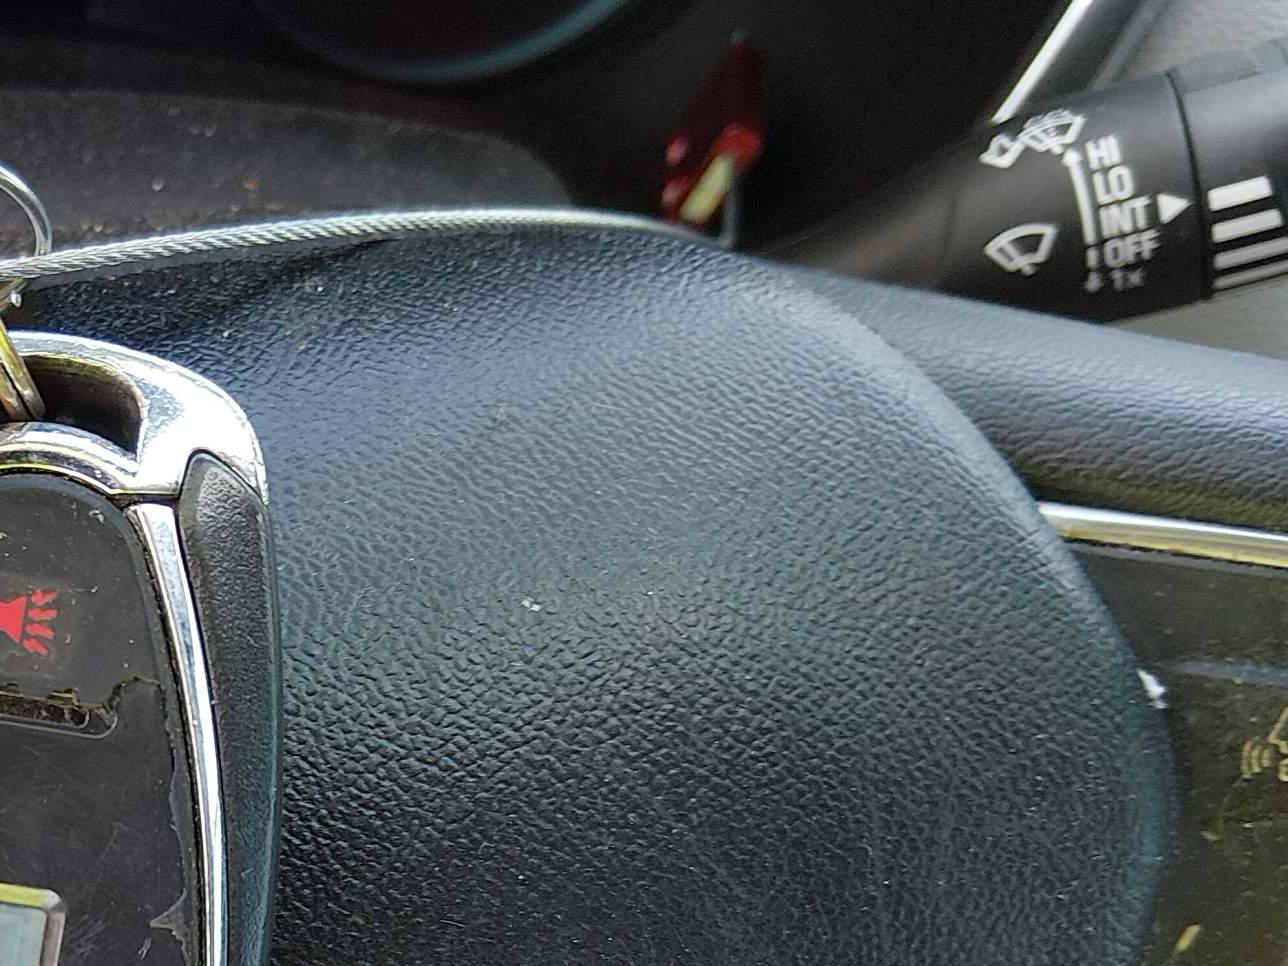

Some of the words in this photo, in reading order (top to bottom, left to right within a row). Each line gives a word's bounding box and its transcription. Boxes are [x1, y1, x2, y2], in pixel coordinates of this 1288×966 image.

[1085, 134, 1123, 170] HI
[1091, 165, 1136, 204] LO
[1098, 195, 1152, 240] INT
[1102, 229, 1161, 269] OFF
